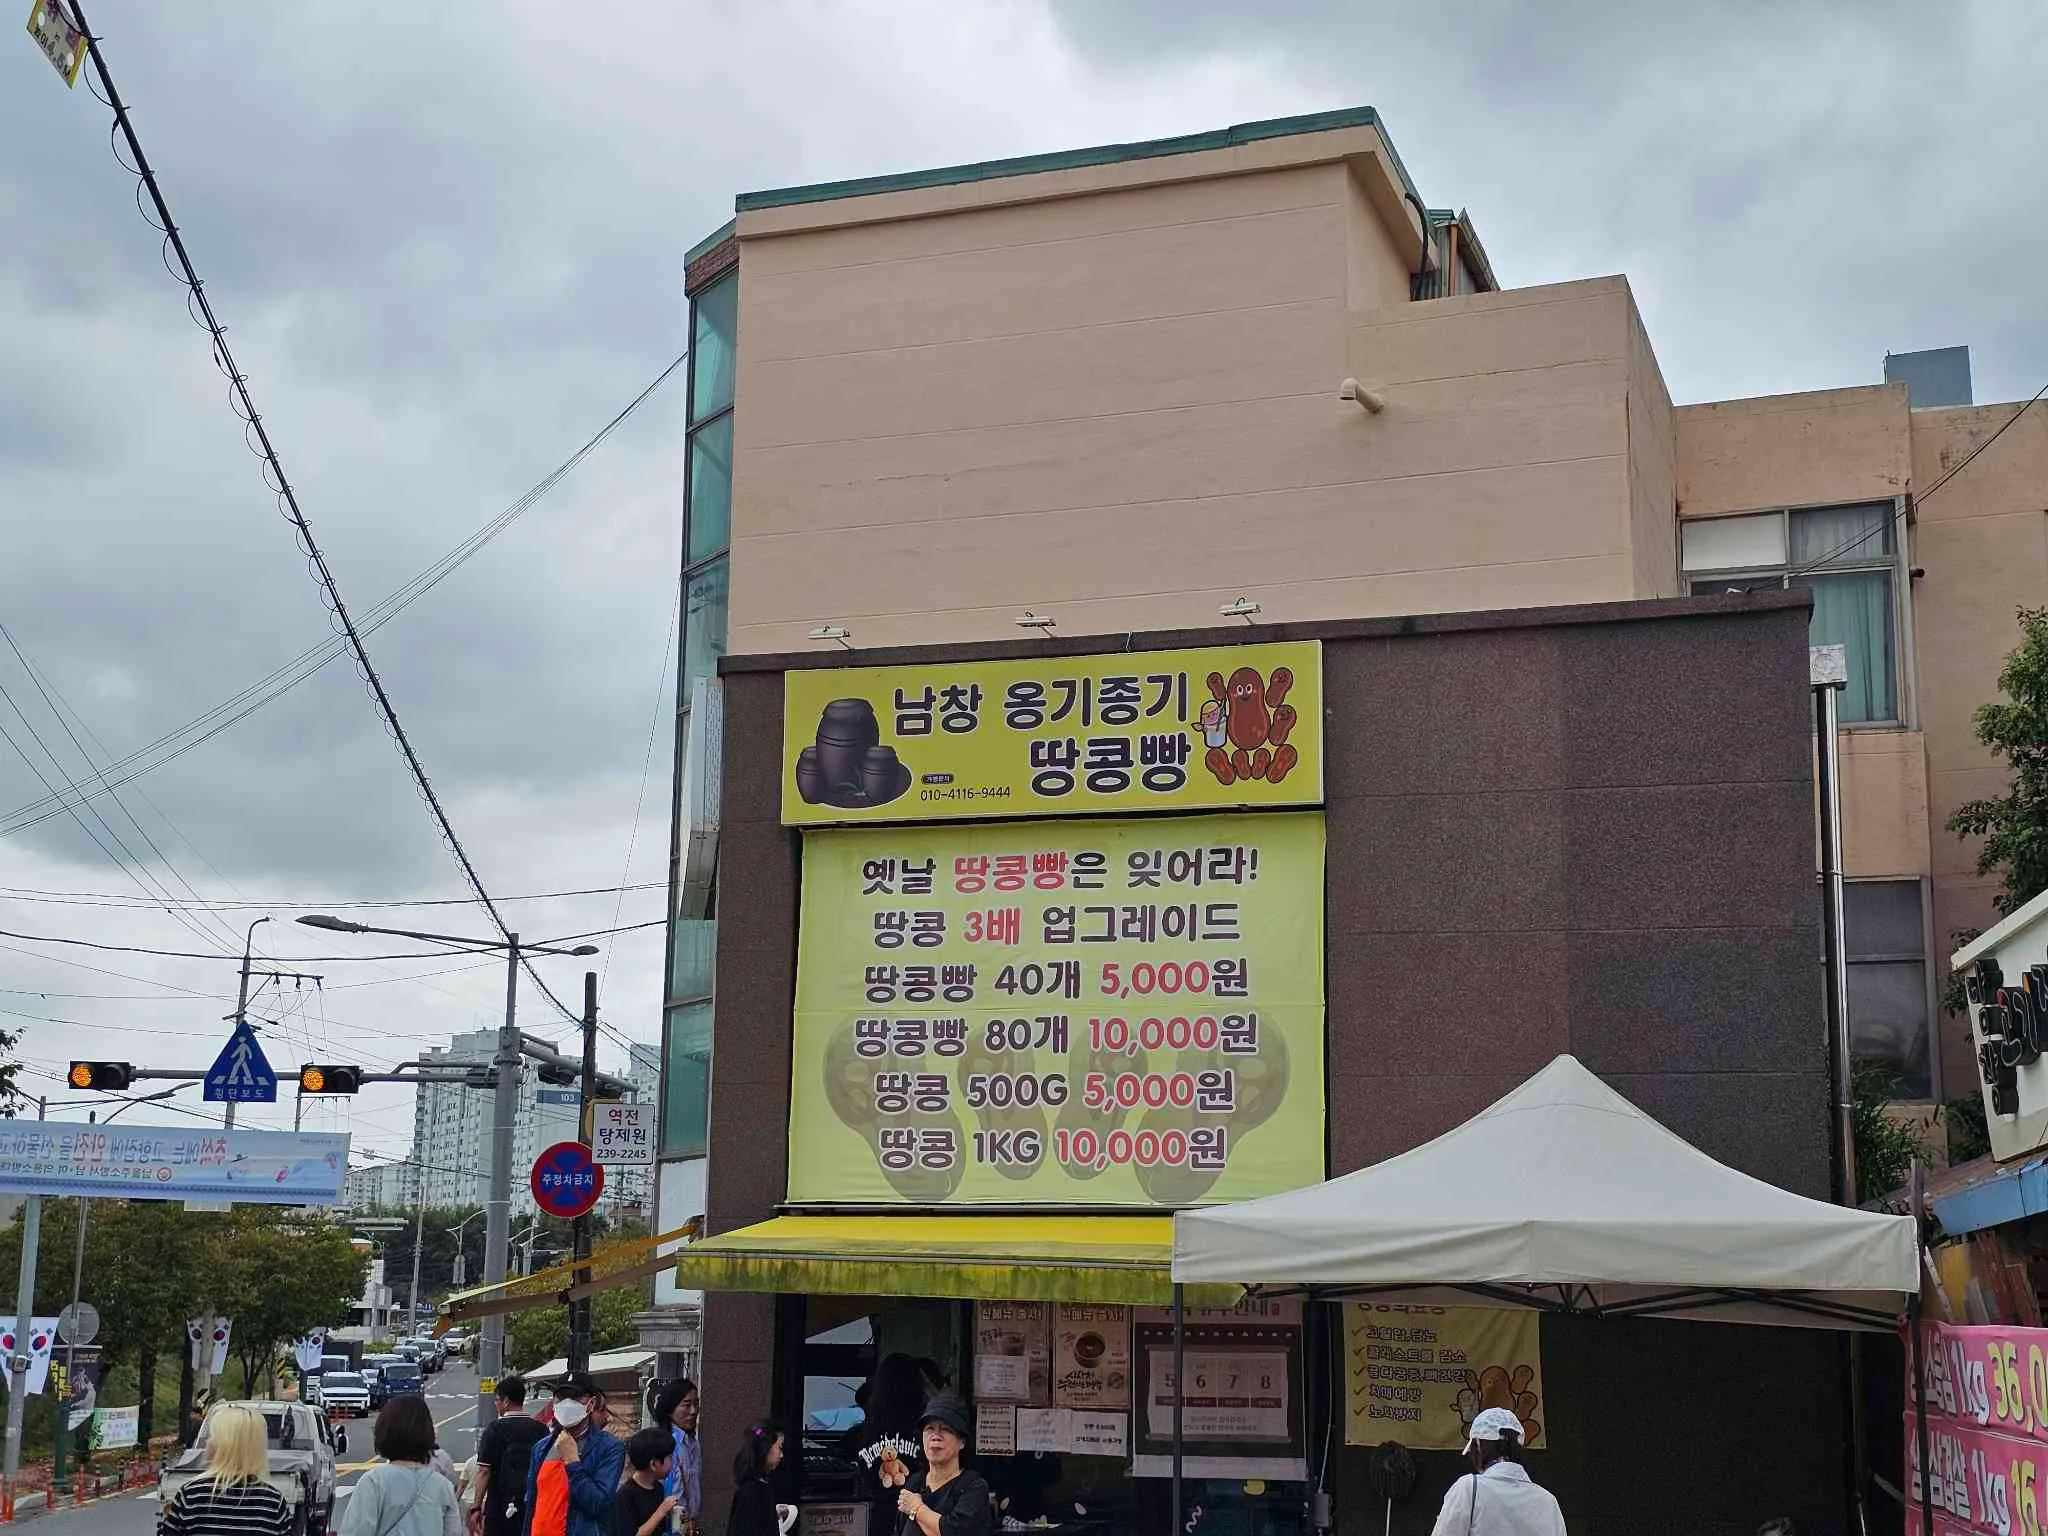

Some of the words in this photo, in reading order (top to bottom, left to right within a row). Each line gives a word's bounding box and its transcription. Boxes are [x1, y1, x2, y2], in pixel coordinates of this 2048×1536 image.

[893, 684, 983, 737] 남창
[1003, 672, 1190, 731] 옹기종기
[1029, 733, 1191, 797] 땅콩빵
[920, 786, 1011, 801] 010-4116-9444
[862, 858, 936, 896] 옛날
[954, 850, 1106, 894] 땅콩빵은
[1127, 847, 1259, 889] 잊어라!
[874, 909, 947, 949] 땅콩
[963, 907, 1022, 946] 3배
[1042, 902, 1242, 945] 업그레이드
[864, 963, 977, 1004] 땅콩빵
[994, 959, 1081, 999] 40개
[1100, 957, 1250, 999] 5,000원
[855, 1017, 969, 1058] 땅콩빵
[985, 1015, 1070, 1054] 80개
[1089, 1013, 1258, 1056] 10,000원
[215, 1088, 265, 1100] 횡단보도
[874, 1072, 950, 1113] 땅콩
[967, 1074, 1068, 1109] 500G
[1083, 1069, 1235, 1112] 5,000원
[600, 1128, 647, 1145] 탕제원
[609, 1108, 639, 1126] 역전
[596, 1149, 647, 1159] 239-2245
[880, 1128, 956, 1170] 땅콩
[973, 1130, 1041, 1166] 1KG
[1056, 1127, 1228, 1170] 10,000원
[542, 1173, 593, 1187] 주정차금지
[1196, 1374, 1206, 1389] 6
[1228, 1374, 1237, 1389] 7
[1260, 1375, 1271, 1389] 8
[1951, 1340, 1990, 1425] 1kg
[1972, 1449, 2011, 1536] 1kg
